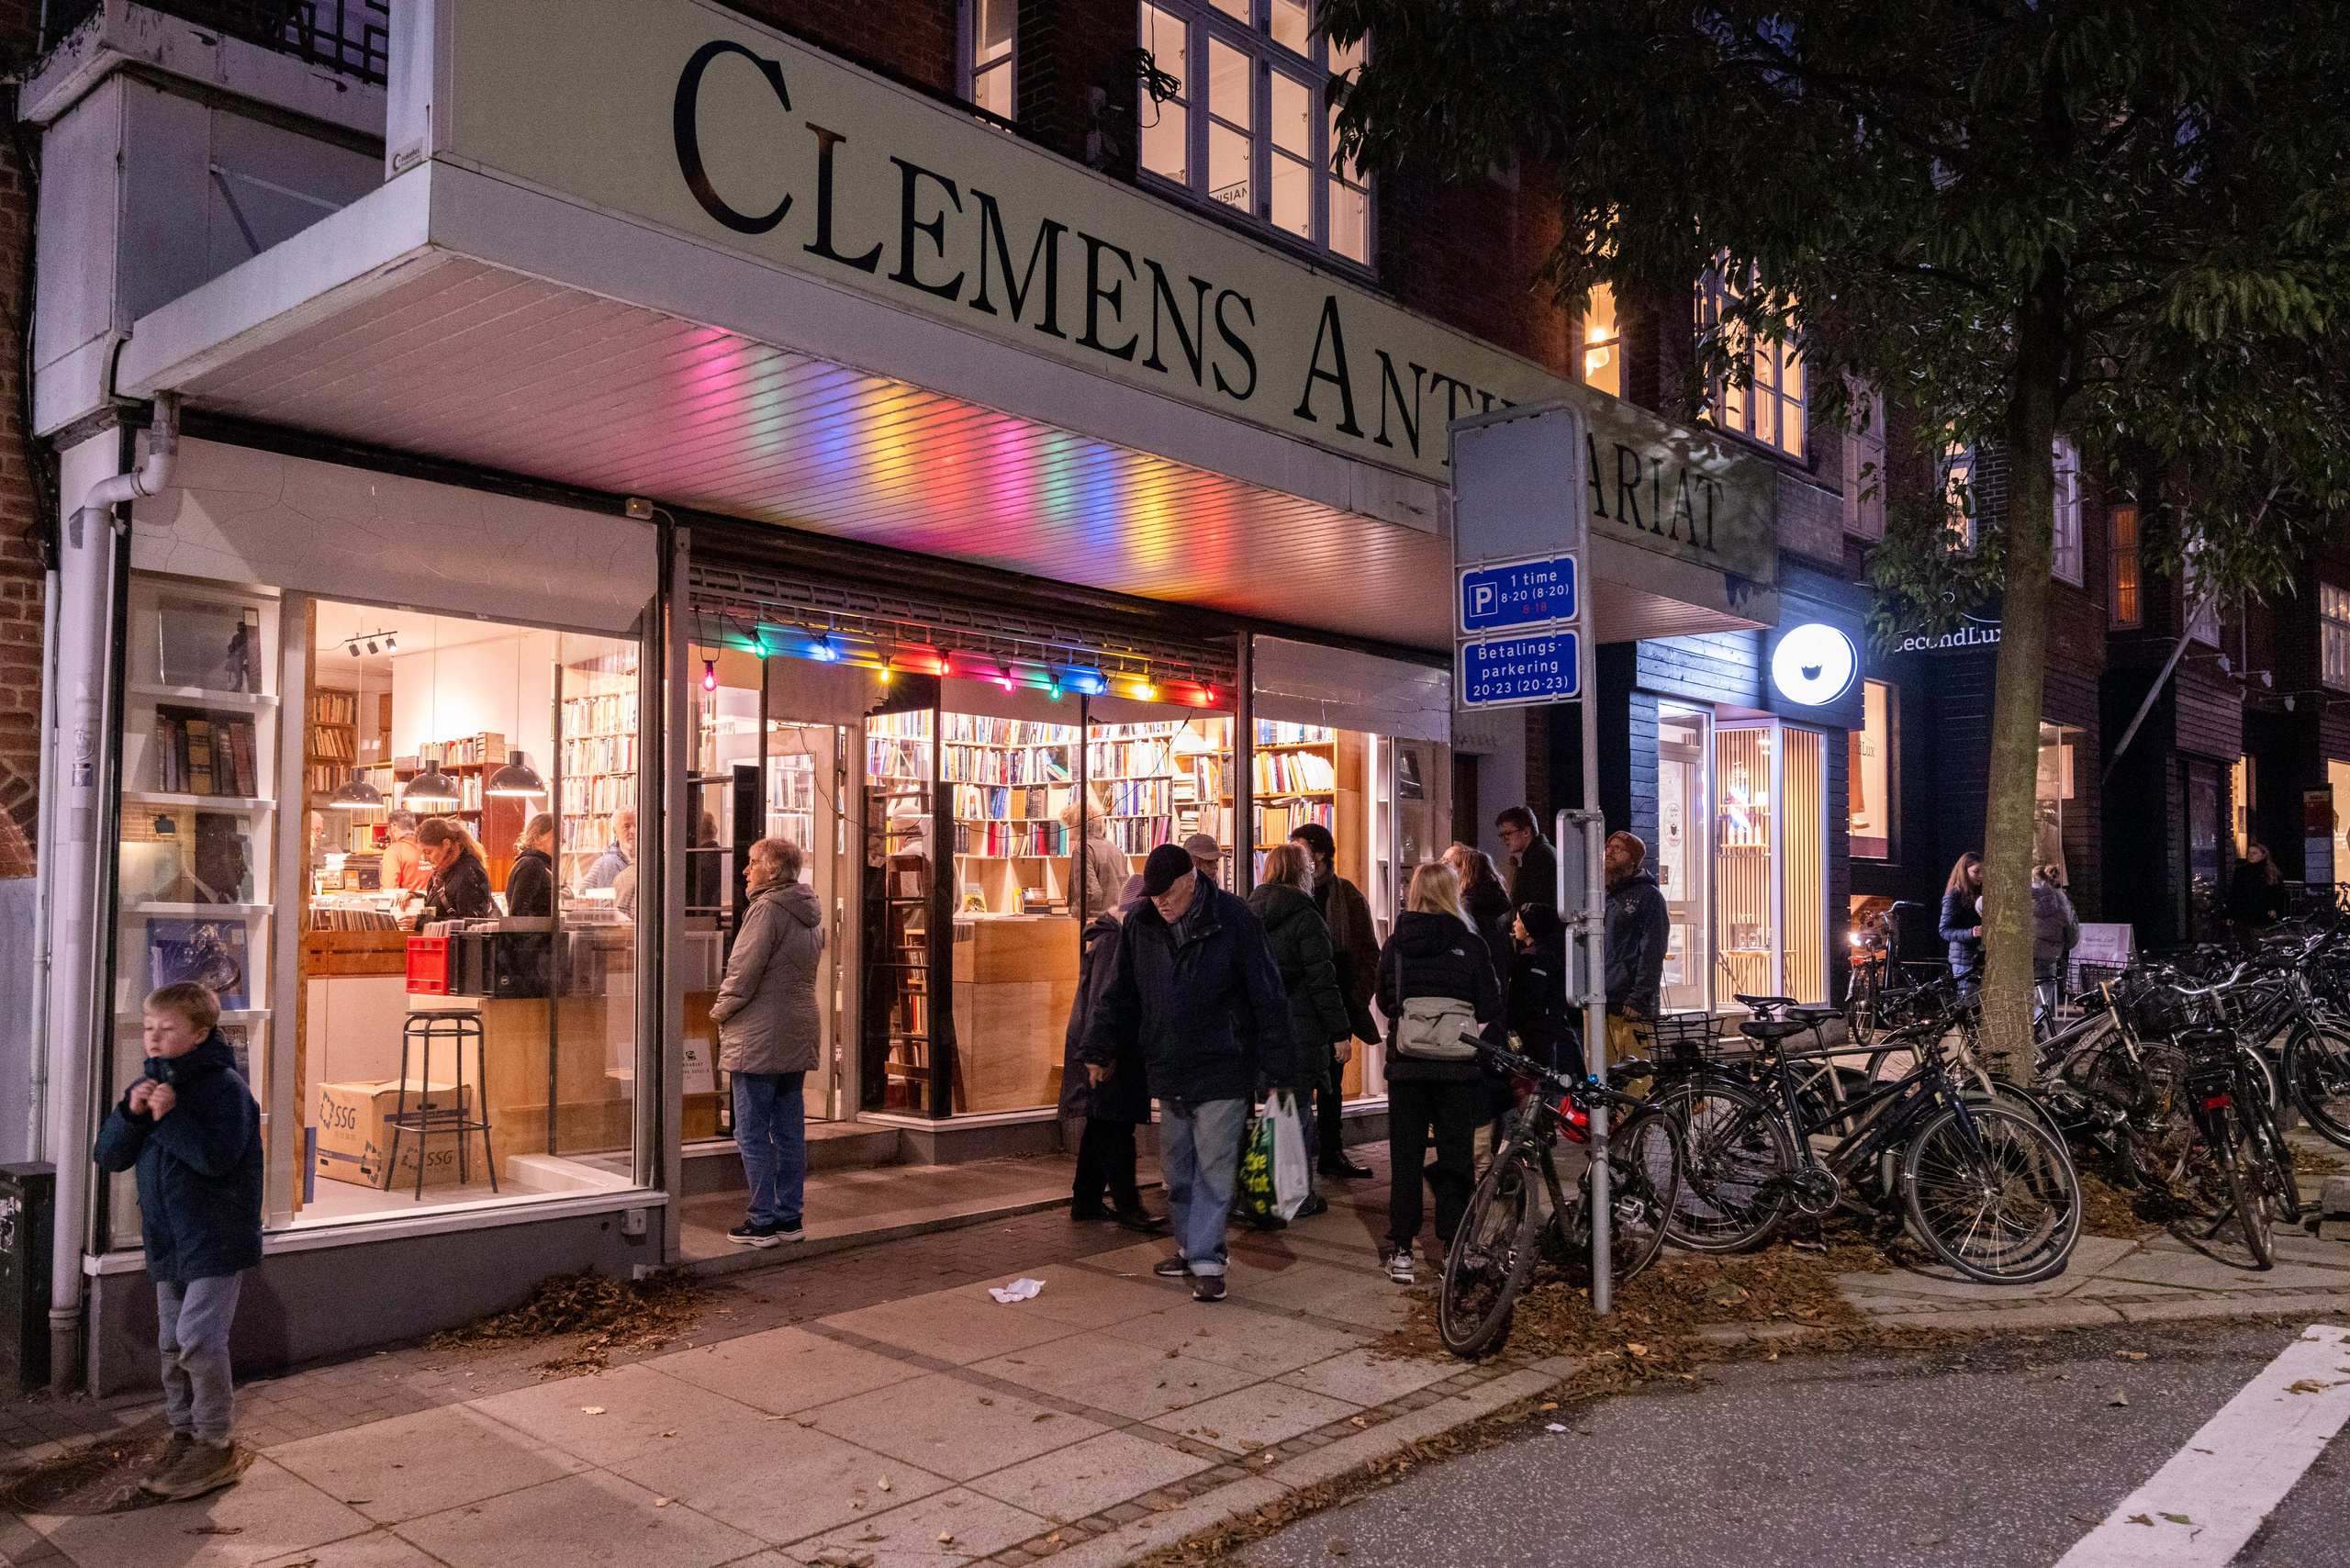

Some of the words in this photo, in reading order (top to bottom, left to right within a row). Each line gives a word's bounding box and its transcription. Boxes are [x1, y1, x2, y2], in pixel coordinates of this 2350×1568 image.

[673, 39, 1258, 400] CLEMENS
[1293, 295, 1725, 554] ANTARIAT
[1510, 575, 1516, 588] 1
[1523, 571, 1558, 586] time
[1475, 587, 1493, 613] P
[1501, 590, 1528, 603] 8-20
[1532, 584, 1570, 599] (8-20)
[1478, 641, 1562, 660] Betalings-
[1482, 660, 1559, 680] parkering
[1473, 682, 1512, 697] 20-23
[1517, 675, 1569, 693] (20-23)
[334, 1105, 356, 1130] SSG
[426, 1149, 453, 1167] SSG
